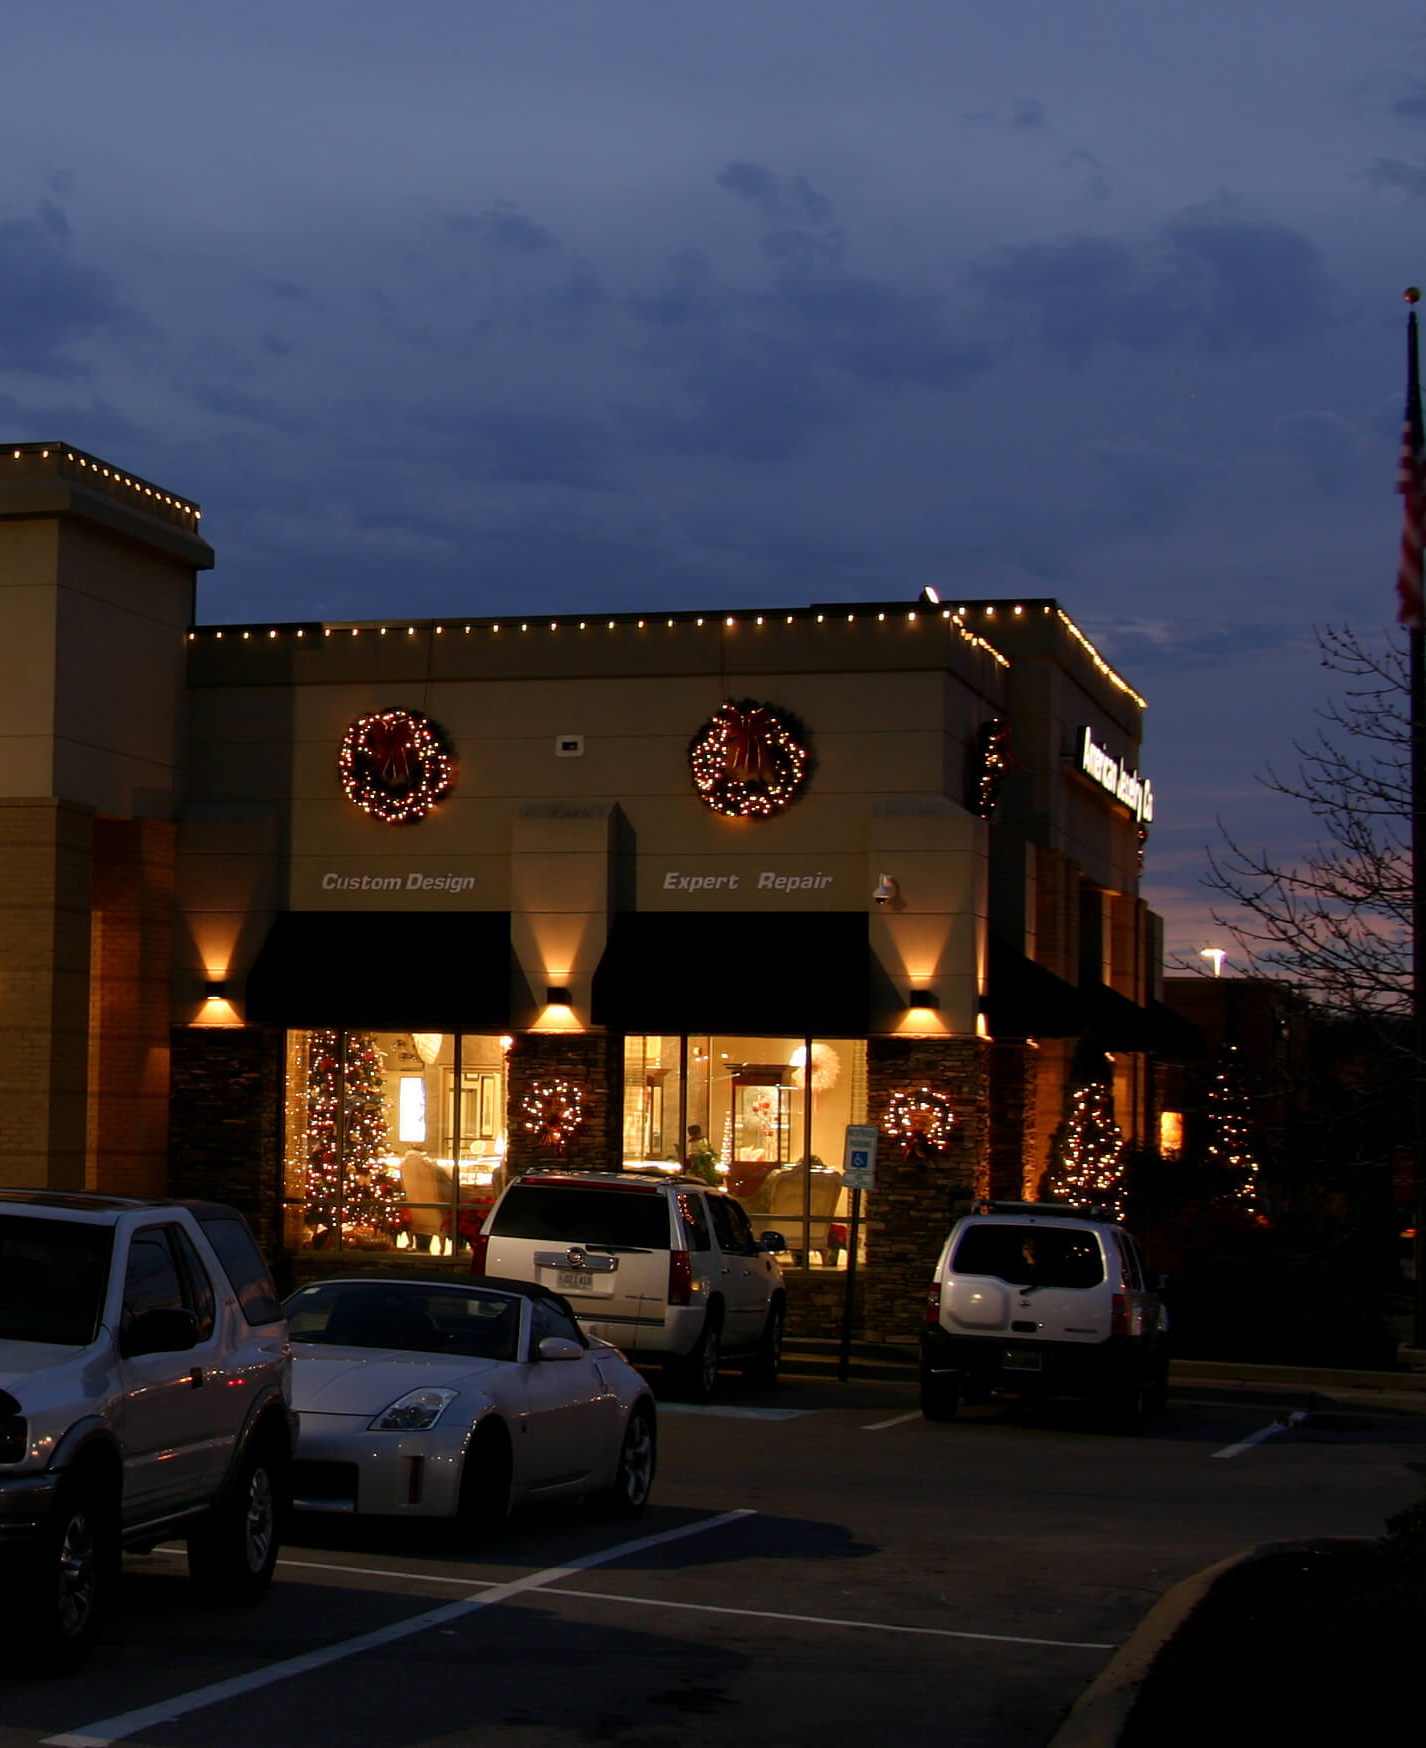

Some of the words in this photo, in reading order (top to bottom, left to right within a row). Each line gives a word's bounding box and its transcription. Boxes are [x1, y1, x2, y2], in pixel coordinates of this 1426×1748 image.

[322, 873, 402, 890] Custom
[406, 873, 476, 893] Design
[663, 872, 740, 893] Expert
[757, 872, 833, 893] Repair
